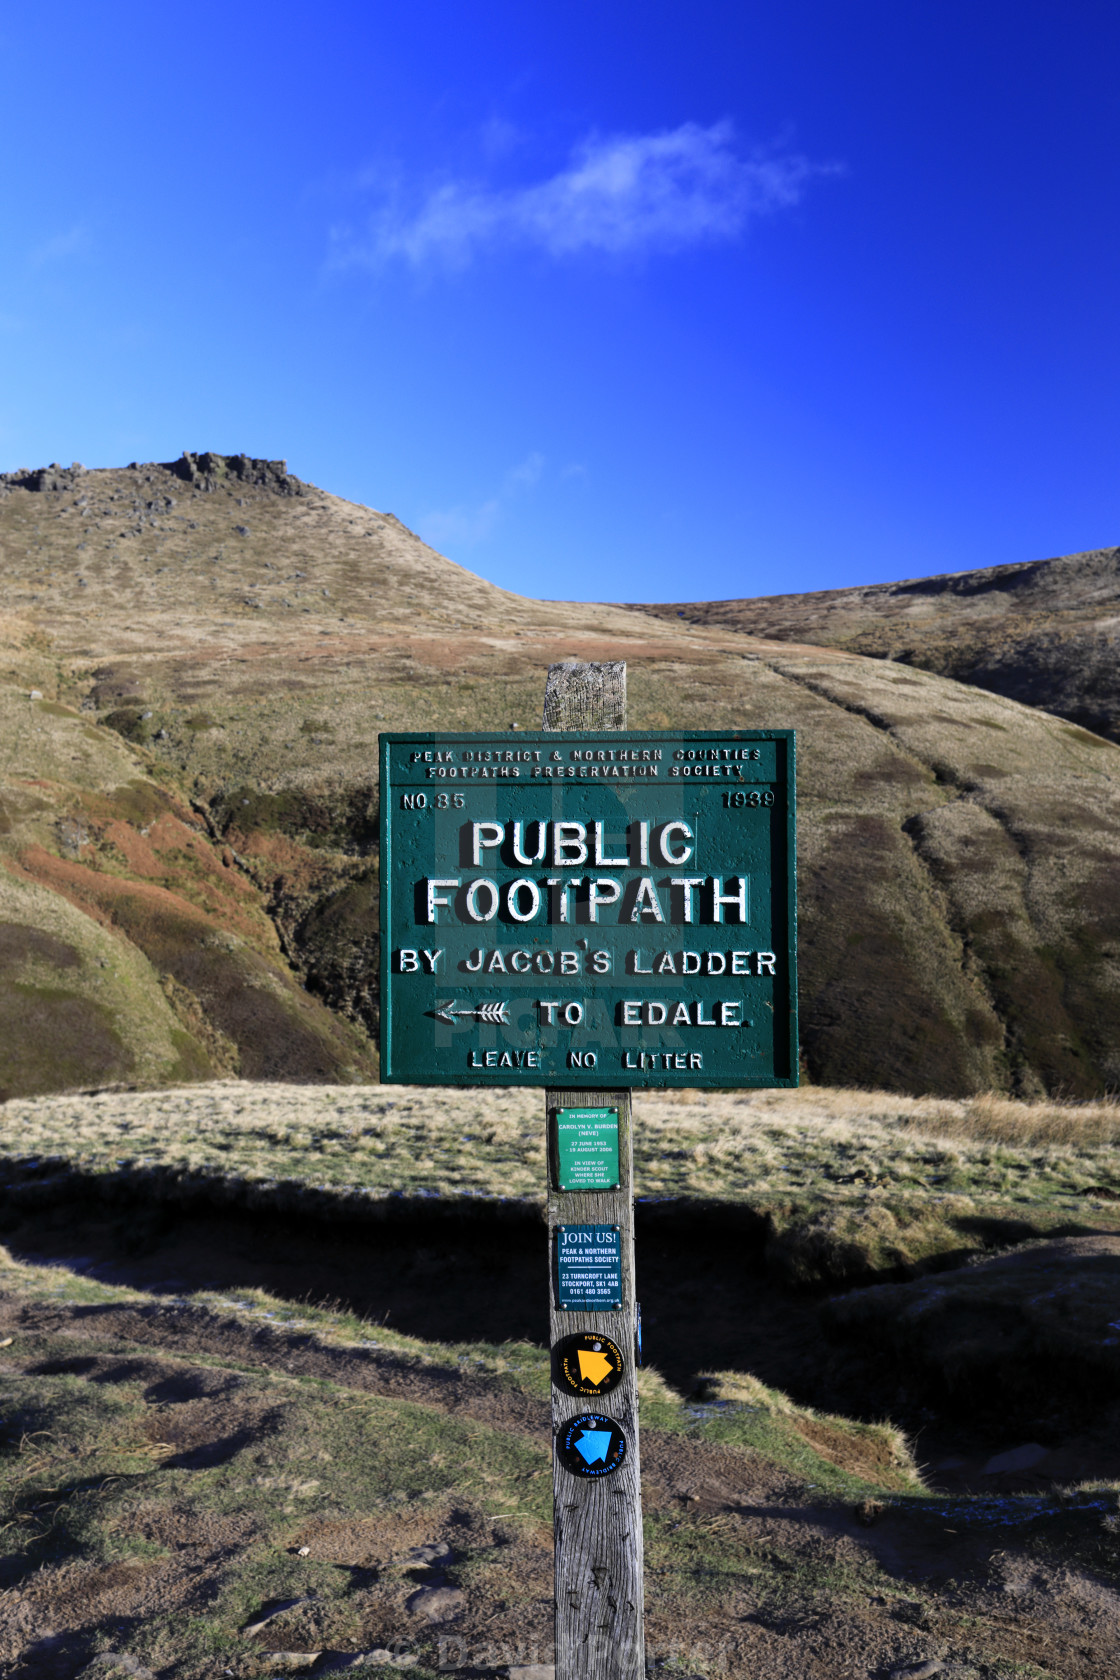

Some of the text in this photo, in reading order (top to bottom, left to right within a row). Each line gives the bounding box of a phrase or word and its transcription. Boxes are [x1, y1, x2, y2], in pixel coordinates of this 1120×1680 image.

[413, 748, 762, 763] PEAK DISTRICT & NORTHERN COUNTIES
[428, 763, 744, 778] FOOTPATHS PRESERVATION SOCIETY
[472, 820, 696, 867] PUBLIC
[427, 877, 749, 924] FOOTPATH
[399, 937, 778, 976] BY JACOB'S LADDER
[539, 1000, 585, 1026] TO
[471, 1050, 704, 1070] LEAVE NO LITTER
[561, 1232, 617, 1246] JOIN US!
[561, 1280, 595, 1288] STOCKPORT,
[584, 1335, 622, 1372] PUBLIC FOOTPATH
[563, 1357, 601, 1395] PUBLIC FOOTPATH
[565, 1414, 609, 1450] PUBLIC BRIDLEWAY
[581, 1462, 617, 1475] BRIDLEWAY
